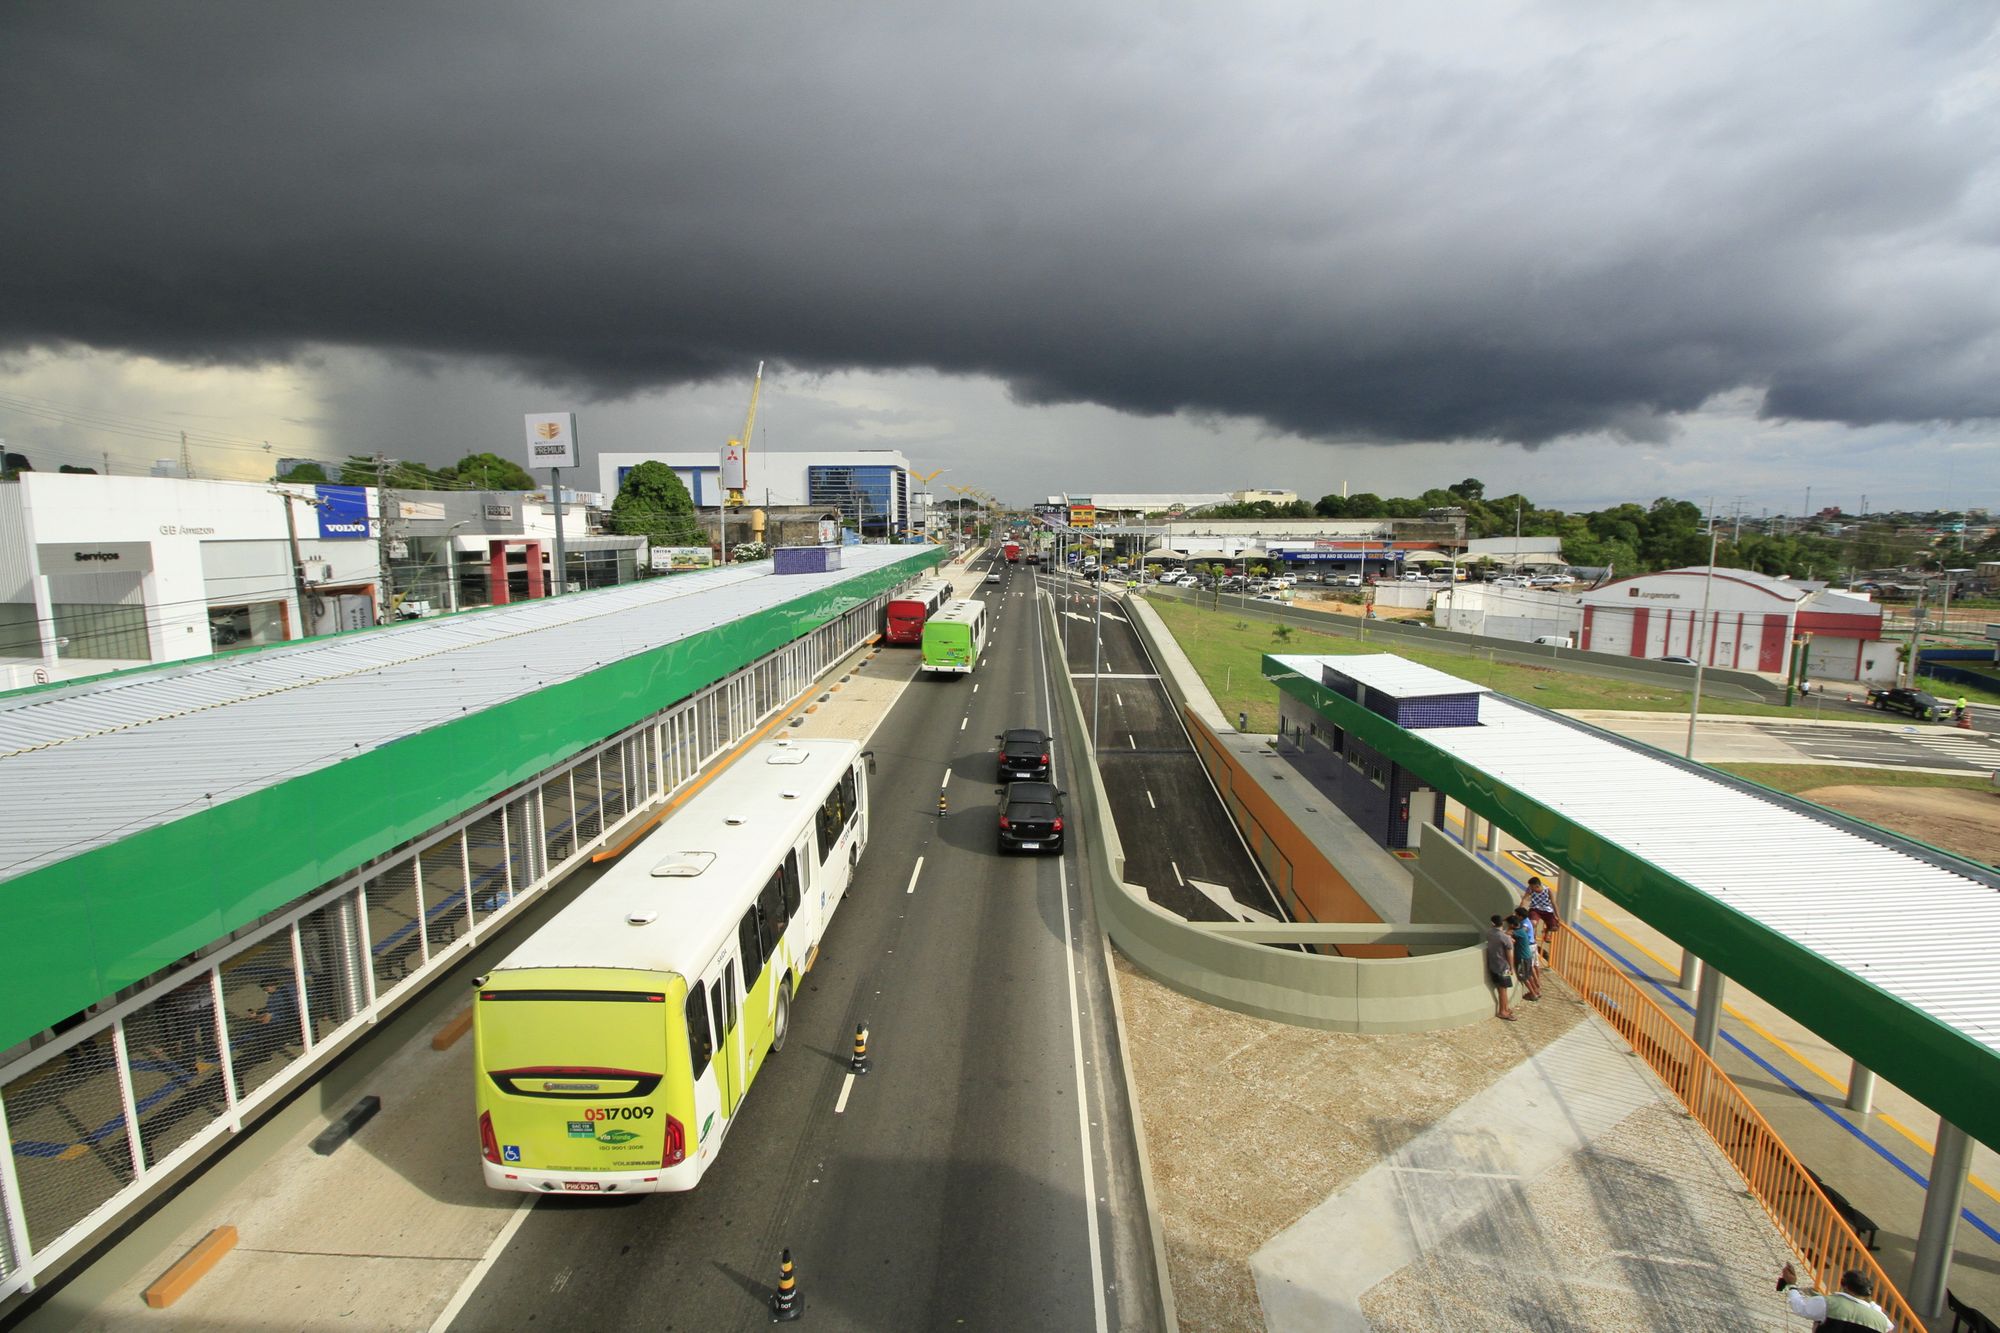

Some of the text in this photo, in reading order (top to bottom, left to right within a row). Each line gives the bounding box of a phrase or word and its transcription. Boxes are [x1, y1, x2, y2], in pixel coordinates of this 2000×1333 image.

[325, 524, 365, 532] VOLVO
[75, 551, 119, 562] Serviços
[585, 1106, 655, 1121] 0517009
